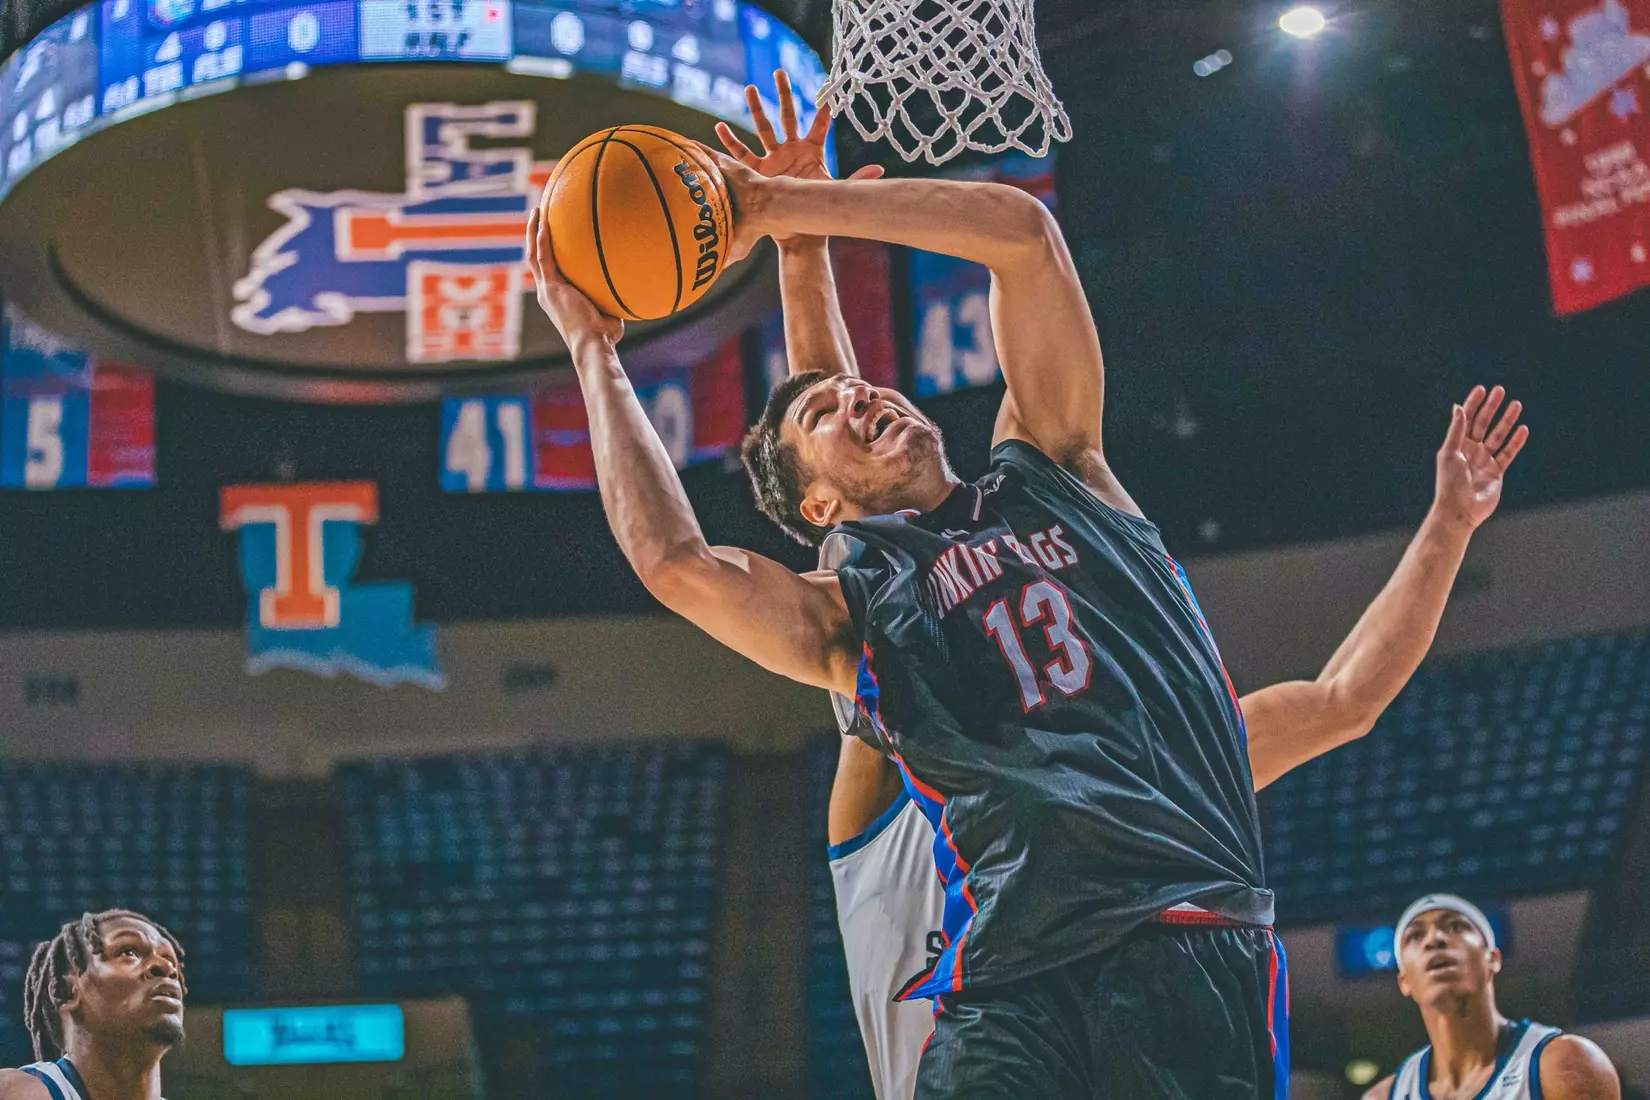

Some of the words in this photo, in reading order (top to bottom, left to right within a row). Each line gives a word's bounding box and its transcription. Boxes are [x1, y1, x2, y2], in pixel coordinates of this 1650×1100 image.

[673, 160, 719, 291] Wilson
[917, 293, 999, 392] 43
[24, 395, 64, 490] 5
[445, 399, 527, 491] 41
[982, 577, 1093, 714] 13
